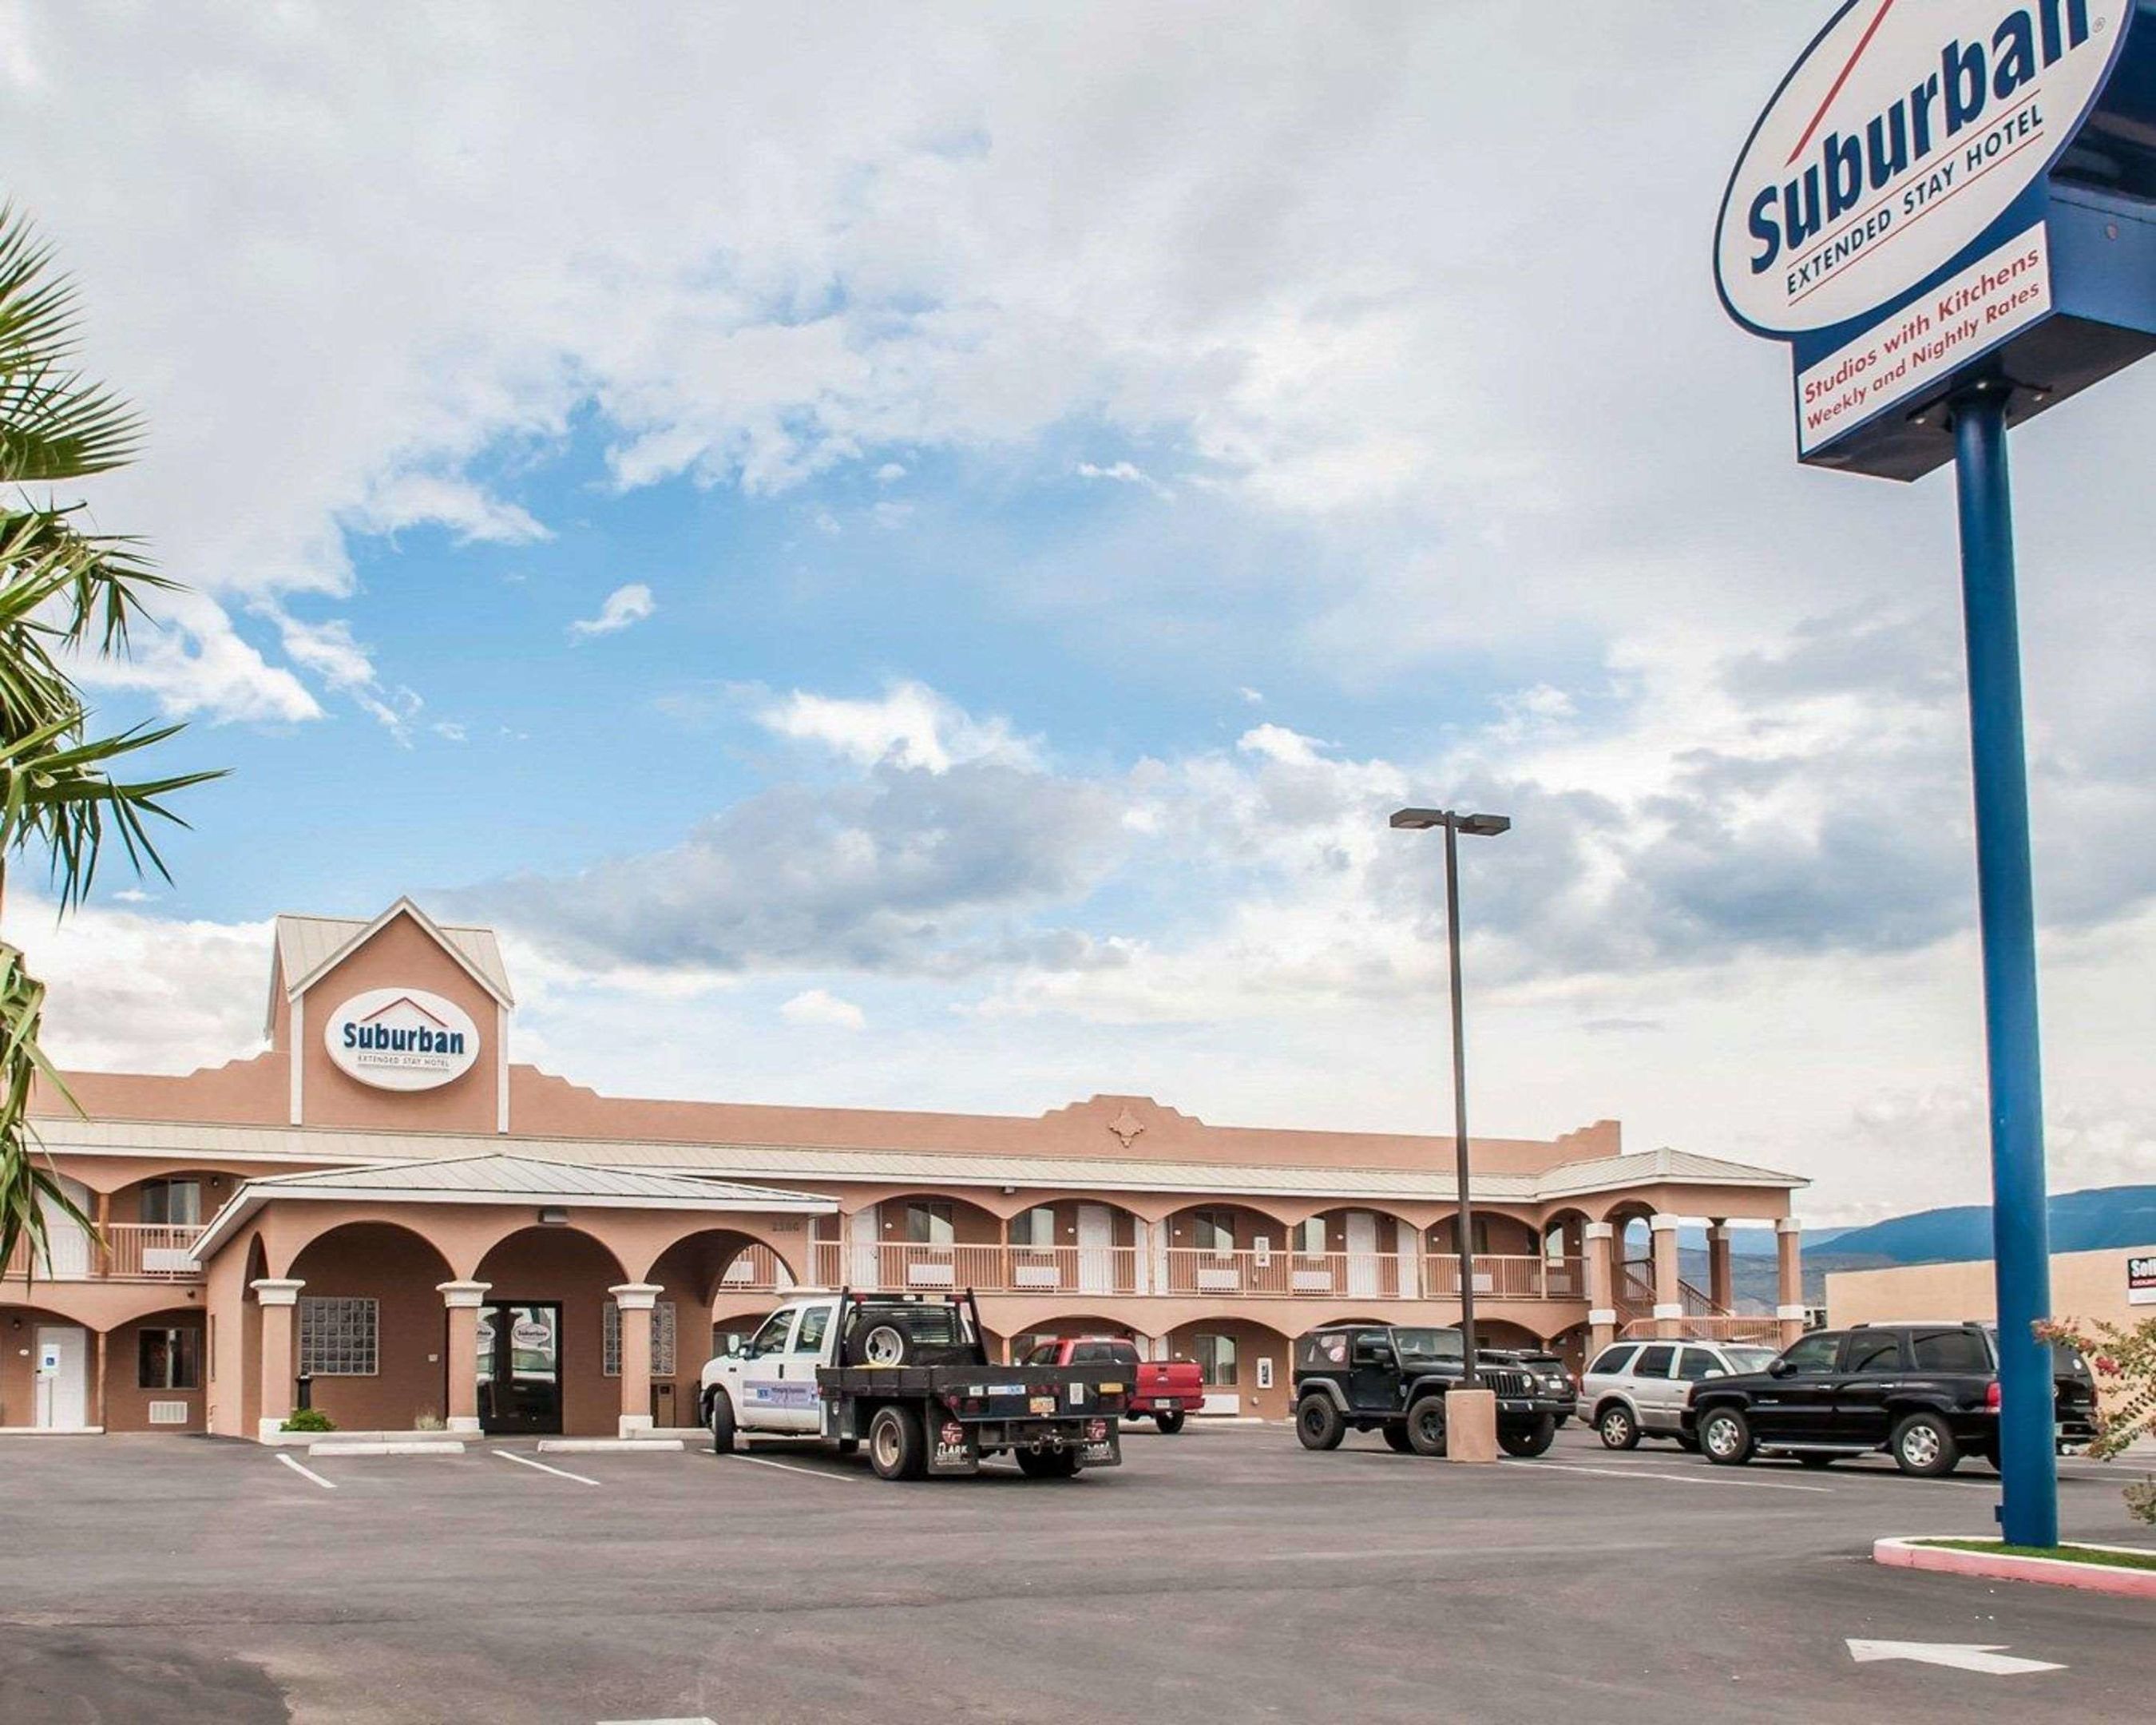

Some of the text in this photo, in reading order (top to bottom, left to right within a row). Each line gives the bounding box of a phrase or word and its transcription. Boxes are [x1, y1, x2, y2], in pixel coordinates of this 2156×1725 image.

[1749, 0, 2088, 274] Suburban
[1787, 104, 2043, 295] EXTENDED STAY HOTEL
[1804, 248, 2039, 405] Studios with Kitchens
[1807, 282, 2039, 430] Weekly and Nightly Rates
[343, 1021, 465, 1055] Suburban
[358, 1055, 450, 1068] EXTENDED STAY HOTEL
